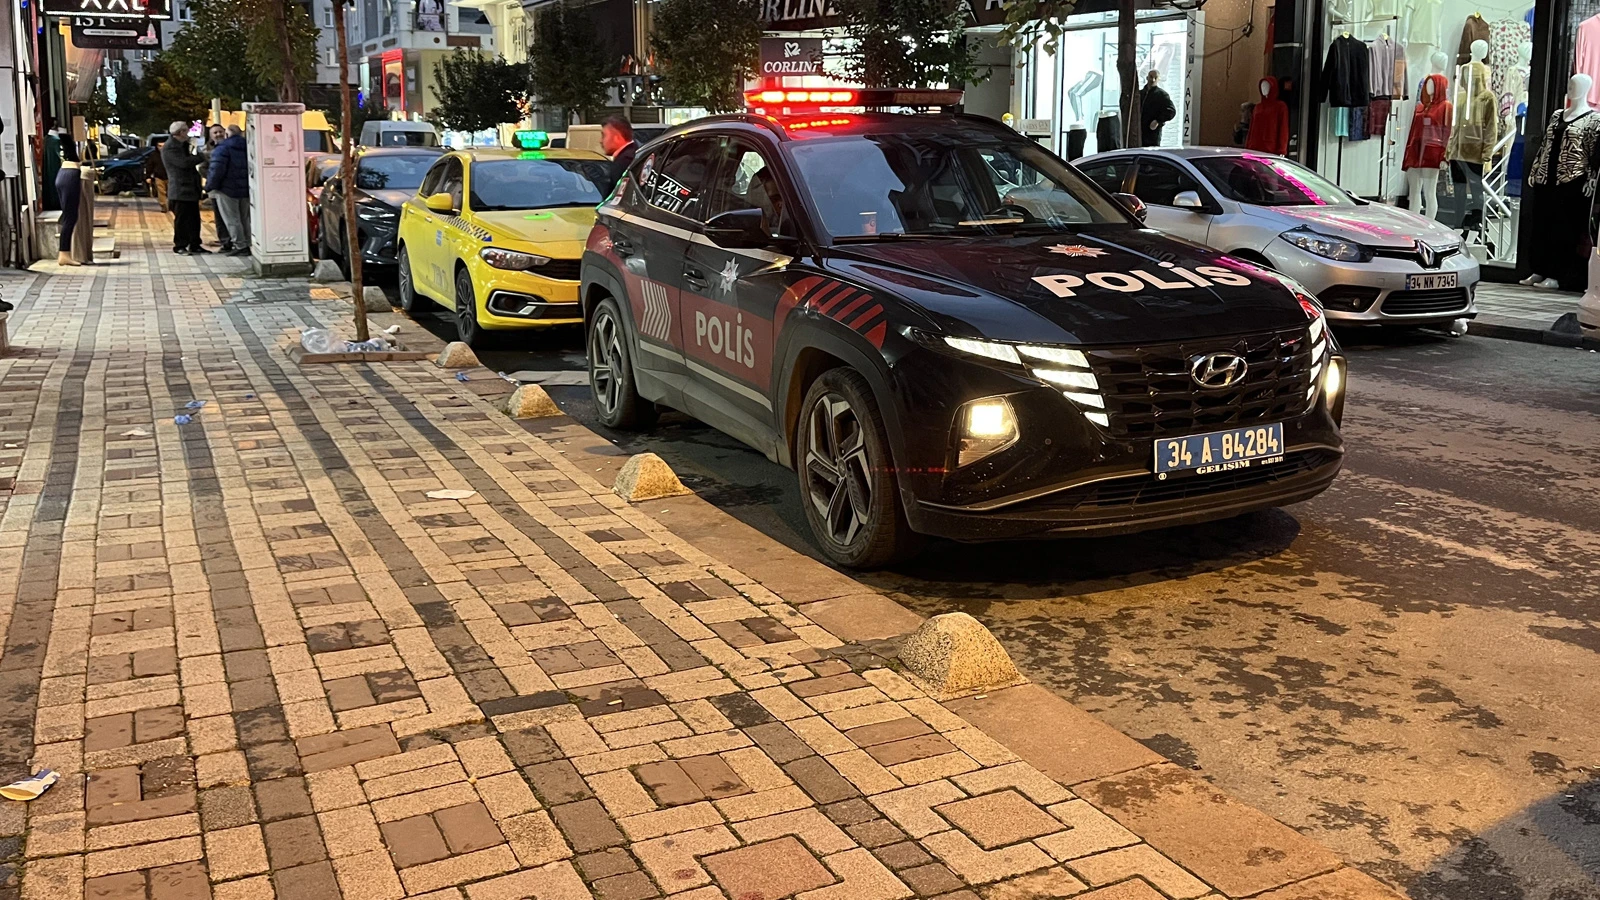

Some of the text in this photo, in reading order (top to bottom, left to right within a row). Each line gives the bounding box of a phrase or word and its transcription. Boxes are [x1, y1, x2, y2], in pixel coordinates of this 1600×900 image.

[1411, 278, 1420, 288] 34
[1167, 427, 1279, 468] 34 A 84284
